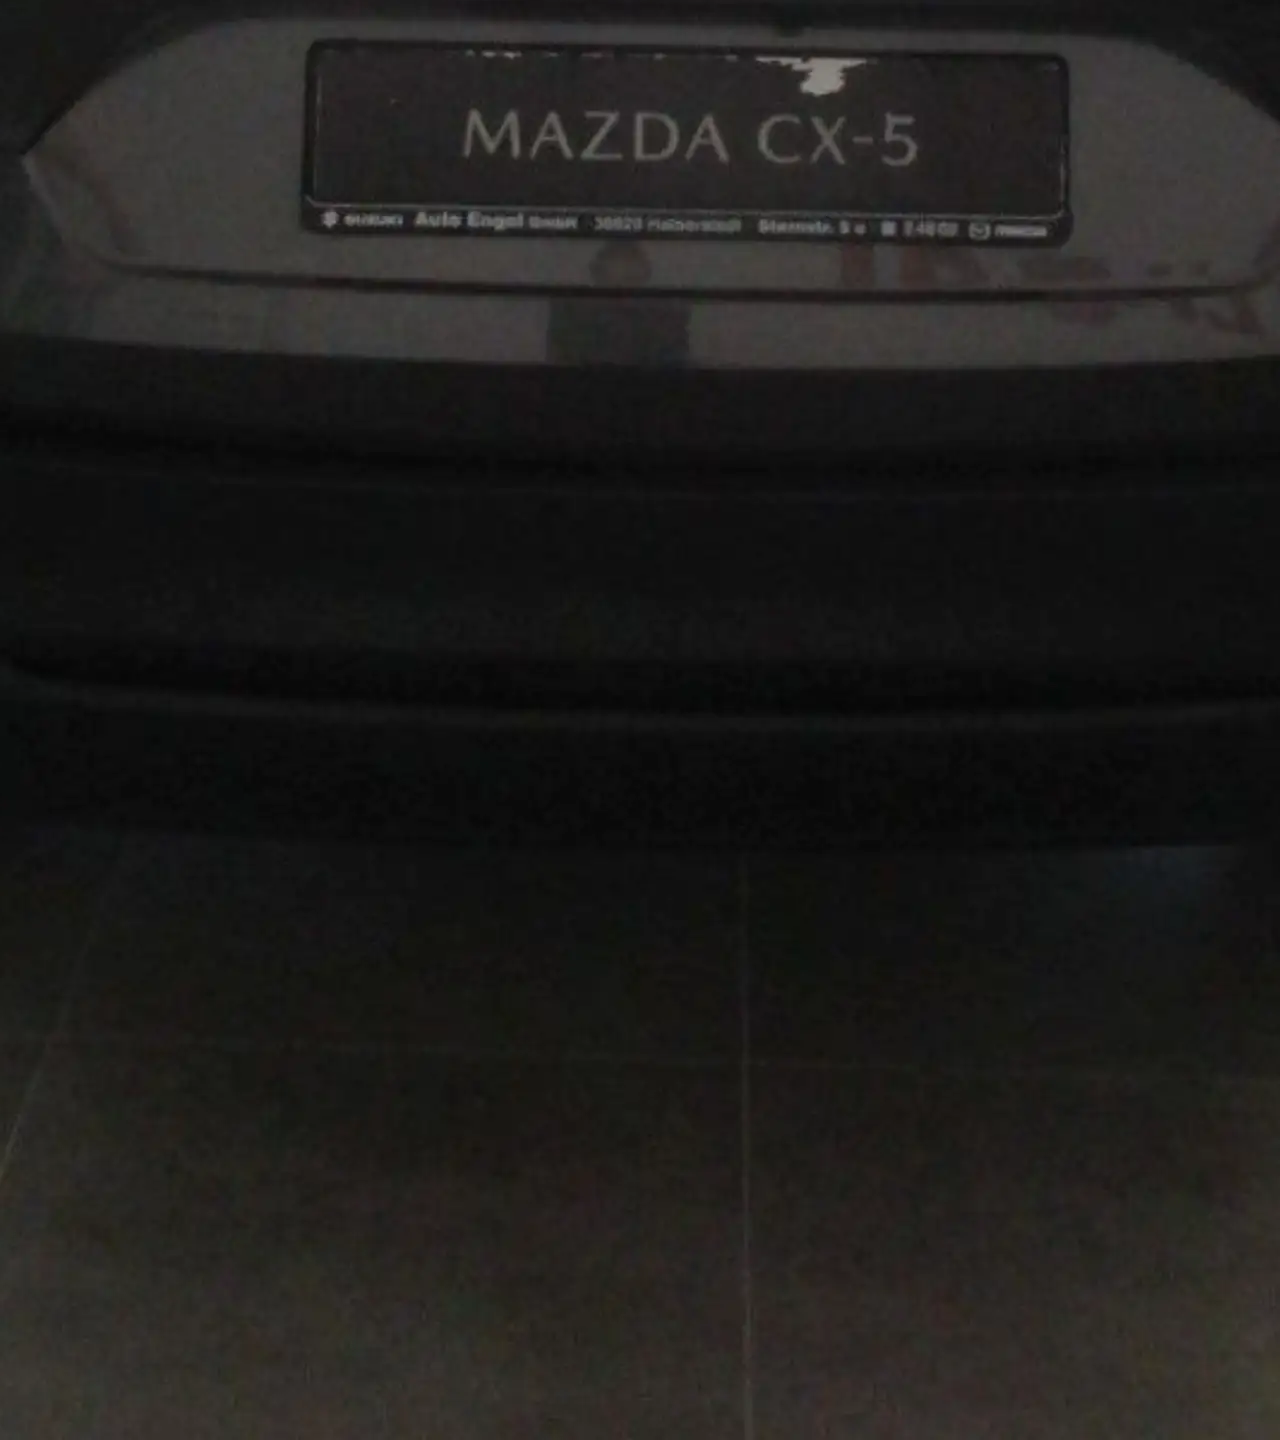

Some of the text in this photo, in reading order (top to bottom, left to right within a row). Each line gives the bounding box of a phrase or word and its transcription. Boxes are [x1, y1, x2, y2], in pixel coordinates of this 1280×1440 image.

[461, 107, 920, 169] MAZDA CX-5
[414, 211, 462, 228] Auto
[466, 210, 524, 231] Engel
